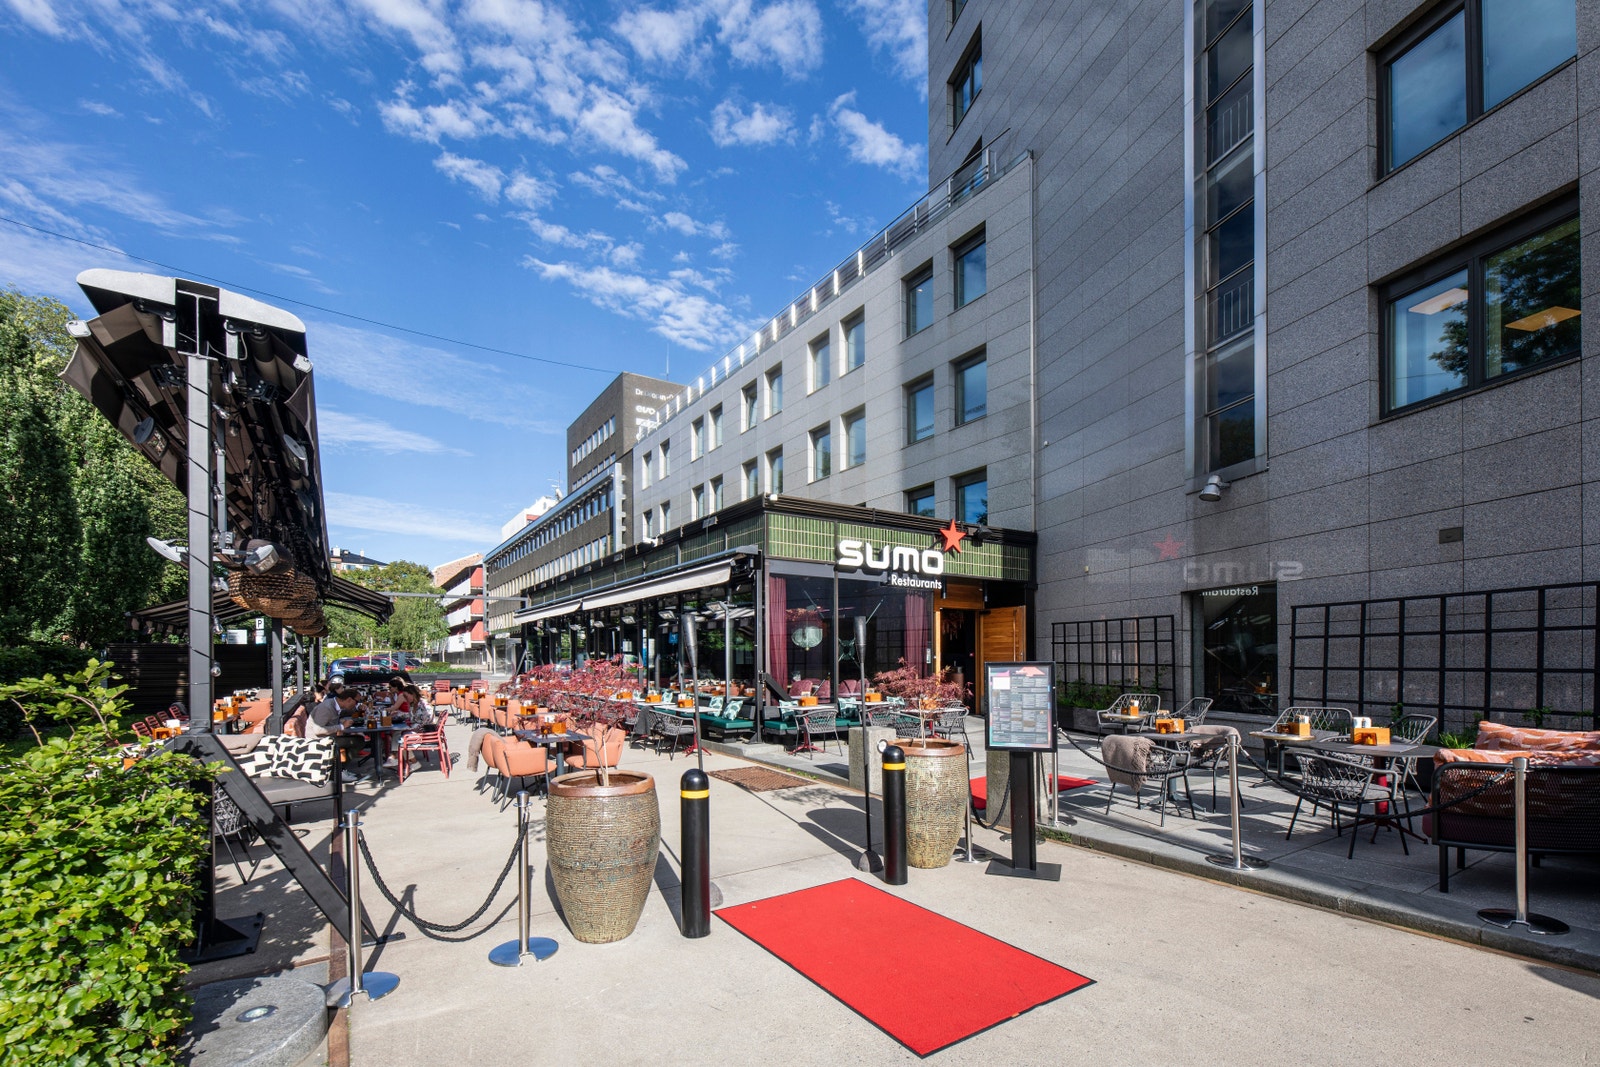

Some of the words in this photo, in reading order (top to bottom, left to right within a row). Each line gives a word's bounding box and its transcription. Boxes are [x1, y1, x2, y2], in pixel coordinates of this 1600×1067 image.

[635, 405, 656, 415] evo
[891, 574, 943, 590] Restaurants
[258, 620, 263, 628] P
